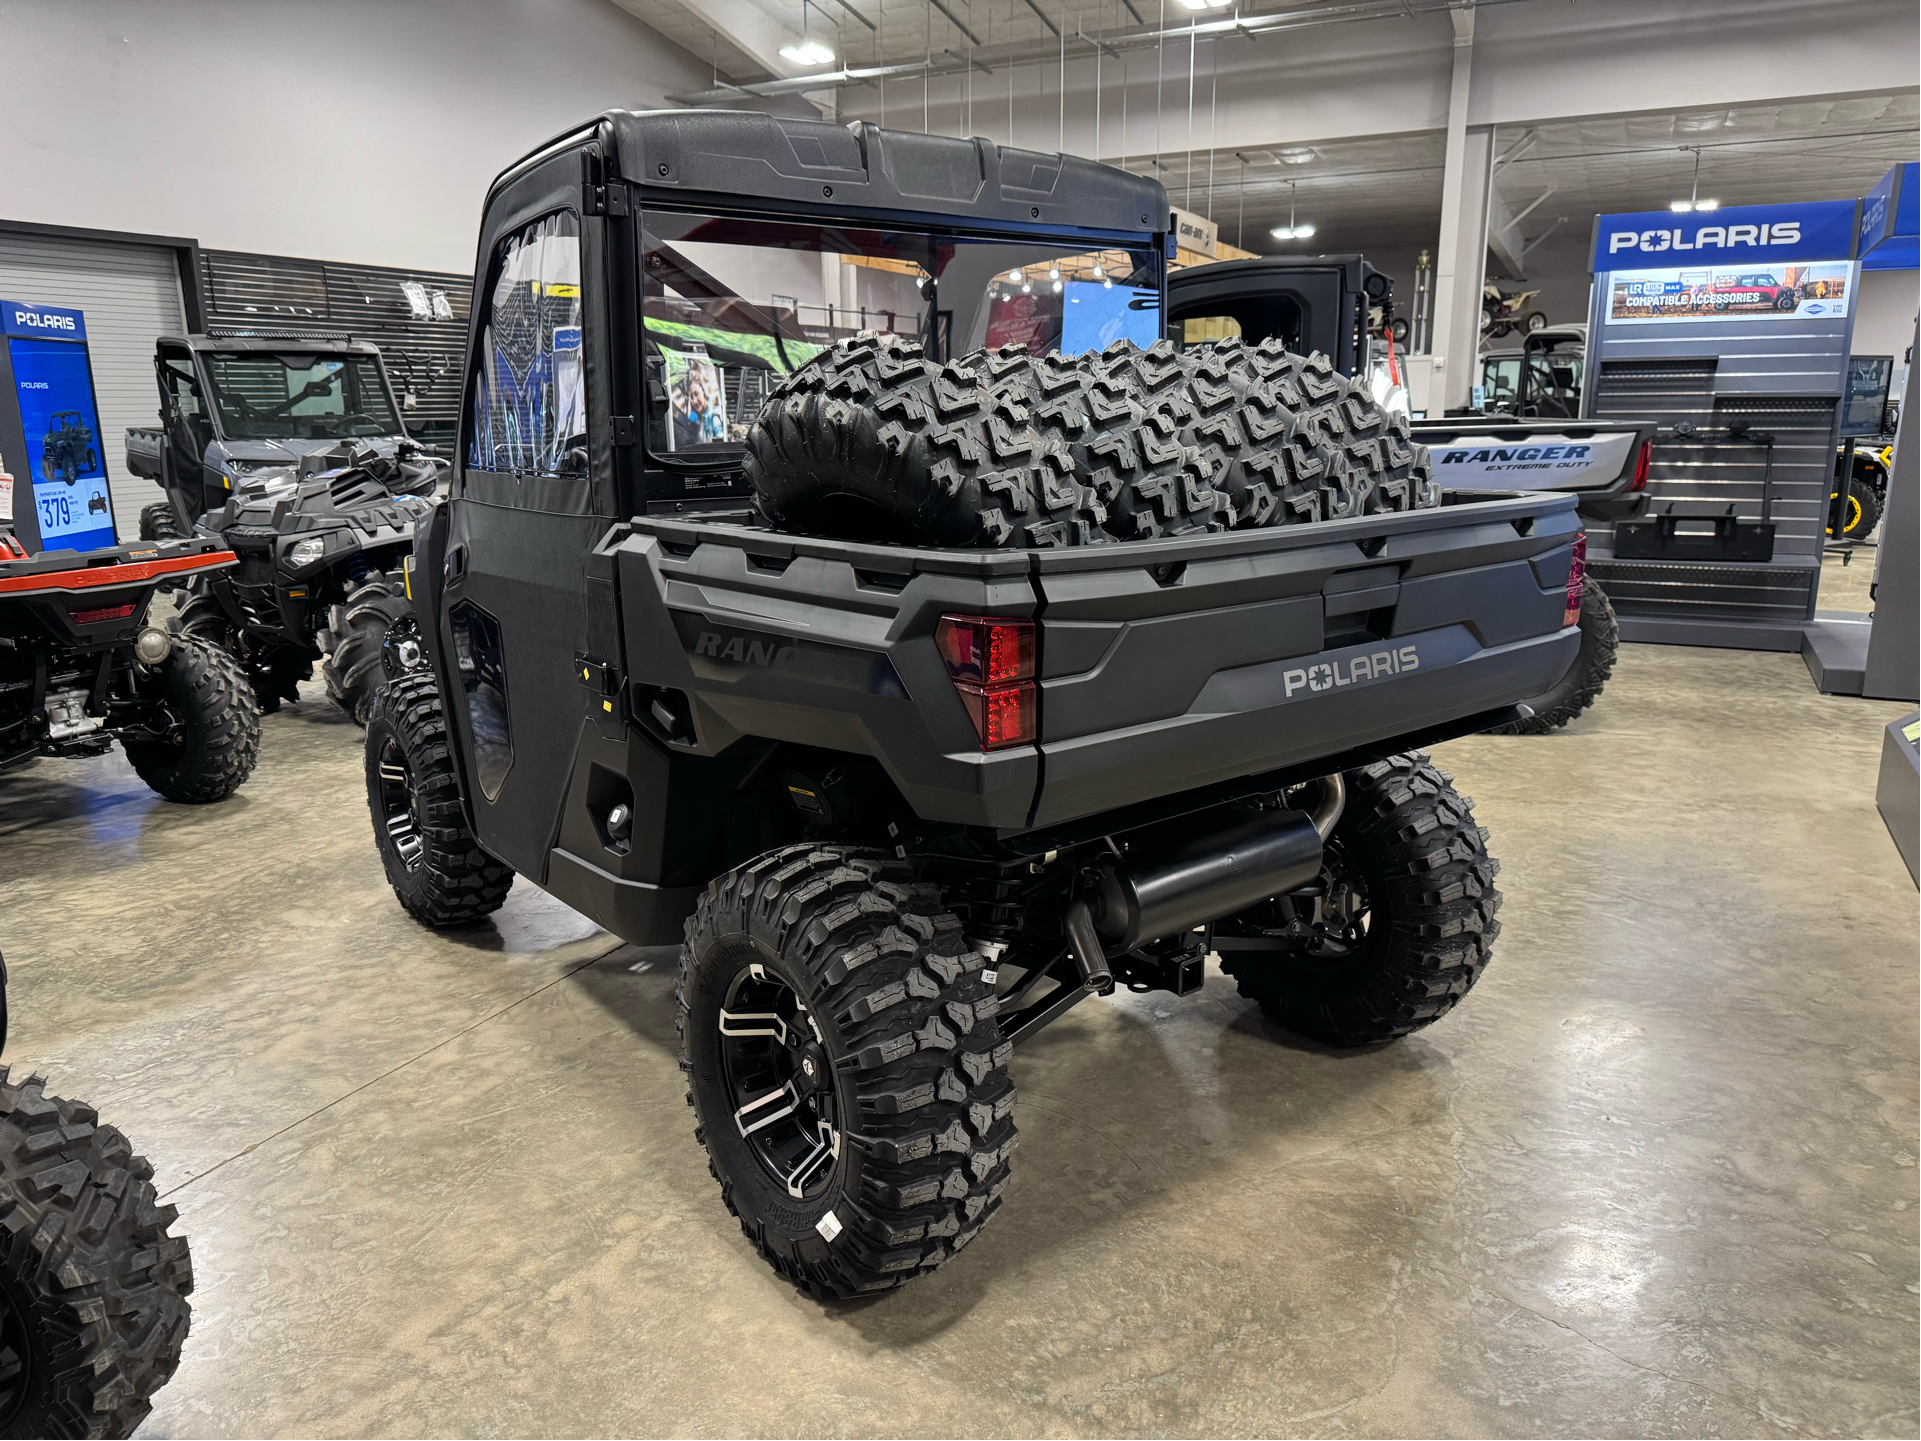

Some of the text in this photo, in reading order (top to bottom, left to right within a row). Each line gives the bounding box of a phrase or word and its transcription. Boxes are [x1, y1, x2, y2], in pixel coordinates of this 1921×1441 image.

[1609, 222, 1801, 253] POLARIS
[1626, 292, 1760, 306] COMPATIBLE ACCESSORIES
[15, 311, 75, 330] POLARIS
[1441, 445, 1591, 464] RANGER
[1485, 462, 1552, 471] EXTREME
[75, 566, 149, 585] POLARIS
[1282, 645, 1419, 697] POLARIS
